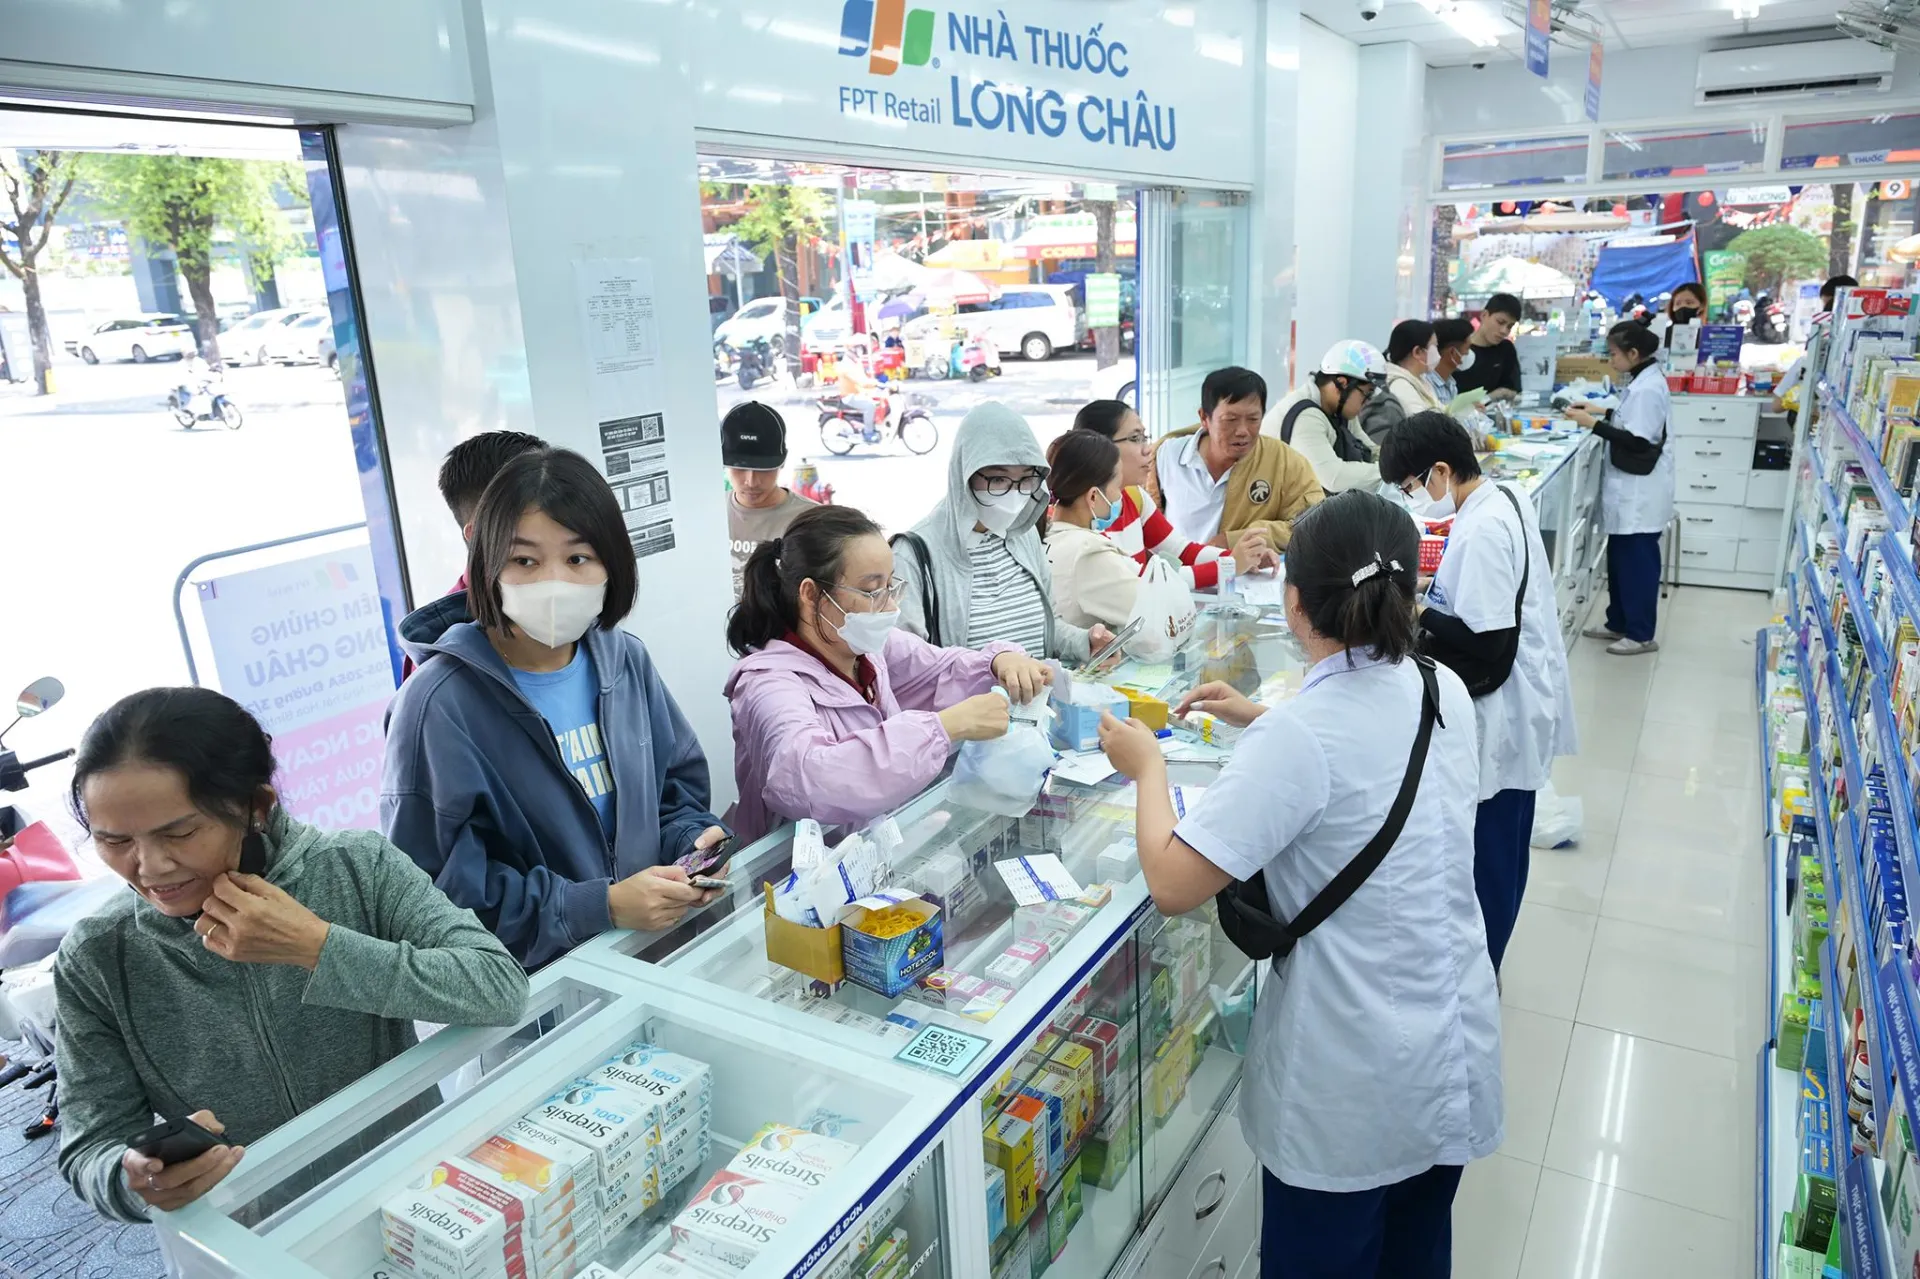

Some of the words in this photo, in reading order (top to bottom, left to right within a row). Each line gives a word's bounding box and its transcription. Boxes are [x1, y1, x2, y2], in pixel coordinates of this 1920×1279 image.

[948, 10, 1018, 61] NHÀ
[1025, 23, 1129, 77] THUỐC
[839, 86, 878, 114] FPT
[885, 92, 941, 124] Retail
[951, 75, 1067, 138] LONG
[1077, 90, 1176, 151] CHÂU
[900, 949, 938, 977] HOTEXCOL
[1886, 983, 1899, 1009] THỰC
[1892, 1008, 1906, 1037] PHẨM
[1899, 1034, 1912, 1061] CHỨC
[602, 1065, 671, 1097] Strepsils
[651, 1068, 681, 1084] COOL
[1048, 1064, 1070, 1078] CEELIN
[1905, 1058, 1919, 1091] NĂNG
[543, 1104, 613, 1138] Strepsils
[592, 1107, 625, 1125] COOL
[512, 1120, 559, 1146] Strepsils
[743, 1153, 826, 1187] Strepsils
[1851, 1183, 1861, 1214] THỰC
[408, 1201, 472, 1242] Strepsils
[691, 1207, 777, 1244] Strepsils
[747, 1206, 788, 1226] Original
[1855, 1212, 1868, 1245] PHẨM
[792, 1240, 829, 1279] KHÔNG
[828, 1223, 842, 1245] KÊ
[1860, 1243, 1872, 1277] CHỨC
